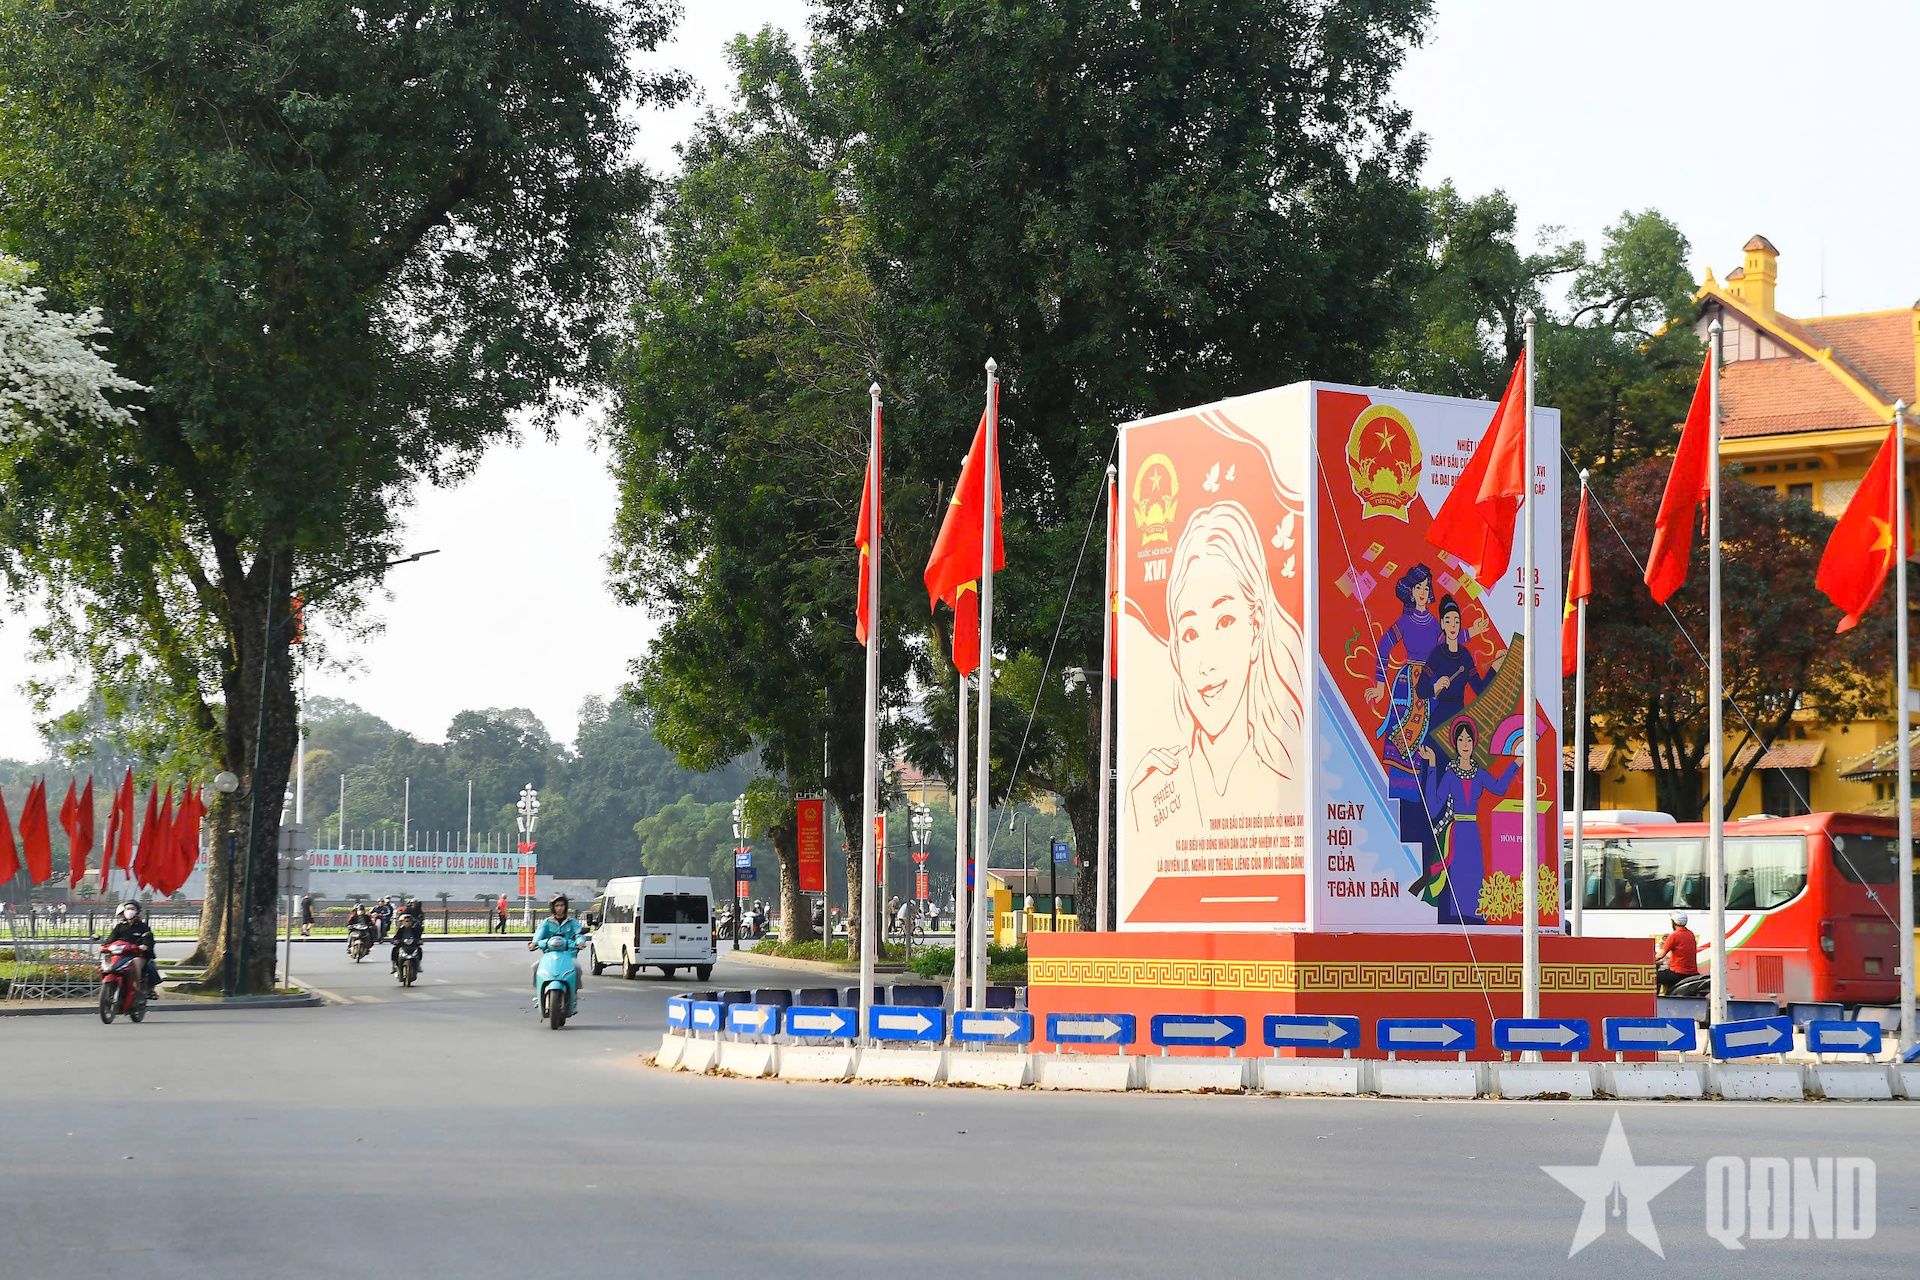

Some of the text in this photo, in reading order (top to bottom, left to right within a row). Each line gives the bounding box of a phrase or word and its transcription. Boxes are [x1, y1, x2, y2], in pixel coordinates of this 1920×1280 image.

[1431, 452, 1446, 467] NGÀY
[1143, 558, 1167, 583] XVI
[1152, 781, 1175, 808] PHIẾU
[1153, 794, 1181, 827] BẦU CỬ
[1327, 800, 1365, 820] NGÀY
[1327, 826, 1352, 849] HỘI
[333, 852, 353, 867] MÃI
[356, 854, 389, 868] TRONG
[392, 854, 406, 870] SỰ
[408, 854, 443, 870] NGHIỆP
[446, 853, 465, 868] CỦA
[468, 855, 499, 869] CHÚNG
[502, 858, 514, 869] TA
[1327, 850, 1356, 871] CỦA
[1327, 877, 1399, 897] TOÀN DÂN
